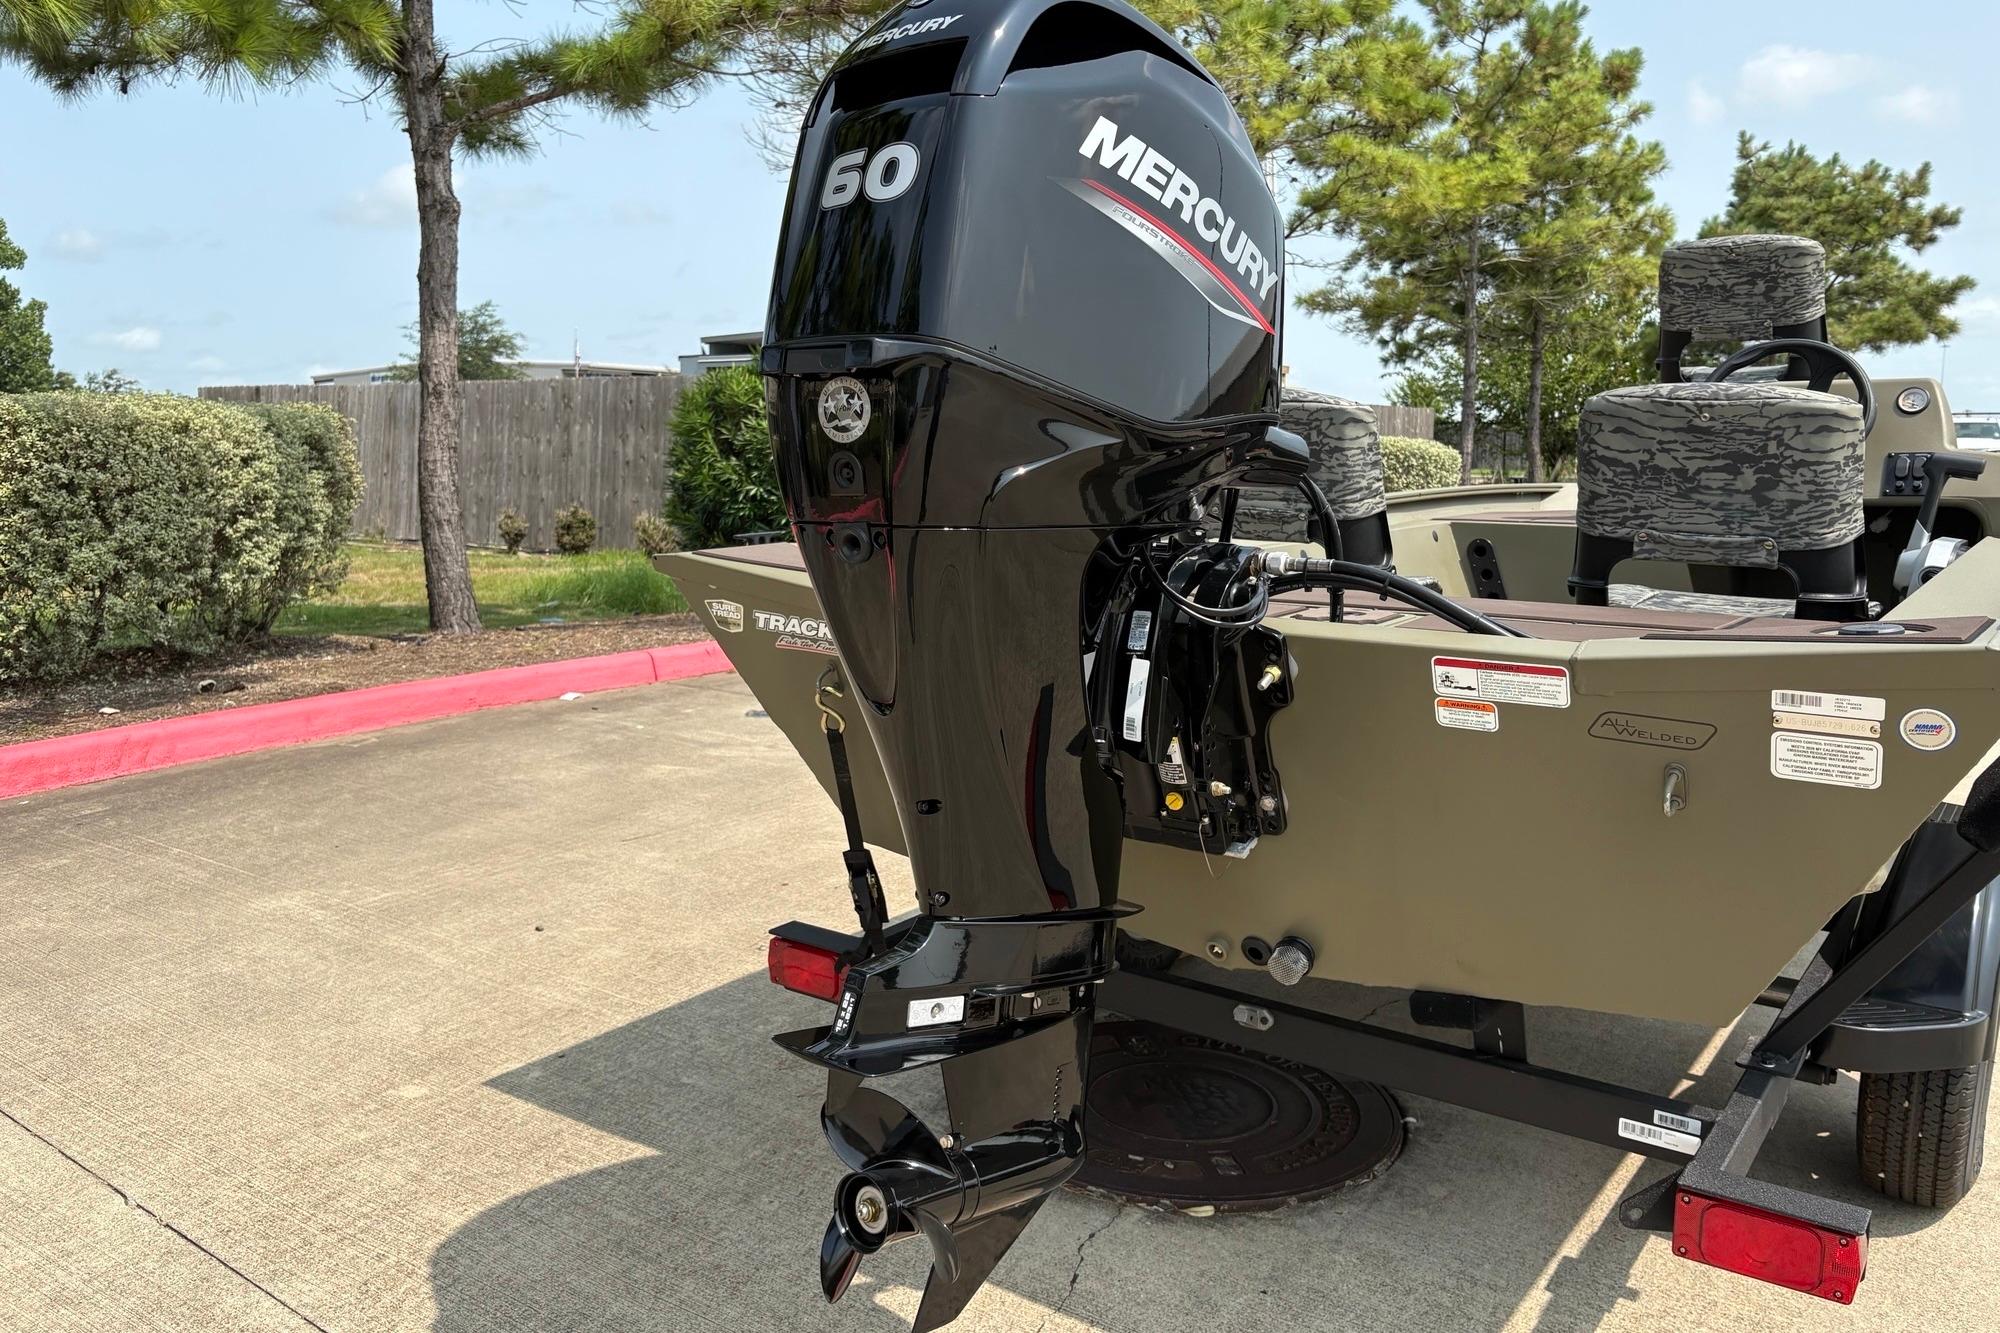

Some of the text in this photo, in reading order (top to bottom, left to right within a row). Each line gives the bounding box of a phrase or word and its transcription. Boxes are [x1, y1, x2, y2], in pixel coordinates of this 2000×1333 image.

[851, 14, 964, 54] MERCURY
[820, 141, 920, 211] 60
[1078, 115, 1279, 301] MERCURY
[711, 602, 737, 612] SURE
[711, 608, 741, 619] TREAD
[1484, 663, 1515, 671] DANGER
[1450, 701, 1481, 709] WARNING
[1601, 717, 1636, 729] ALL
[1614, 726, 1697, 745] WELDED
